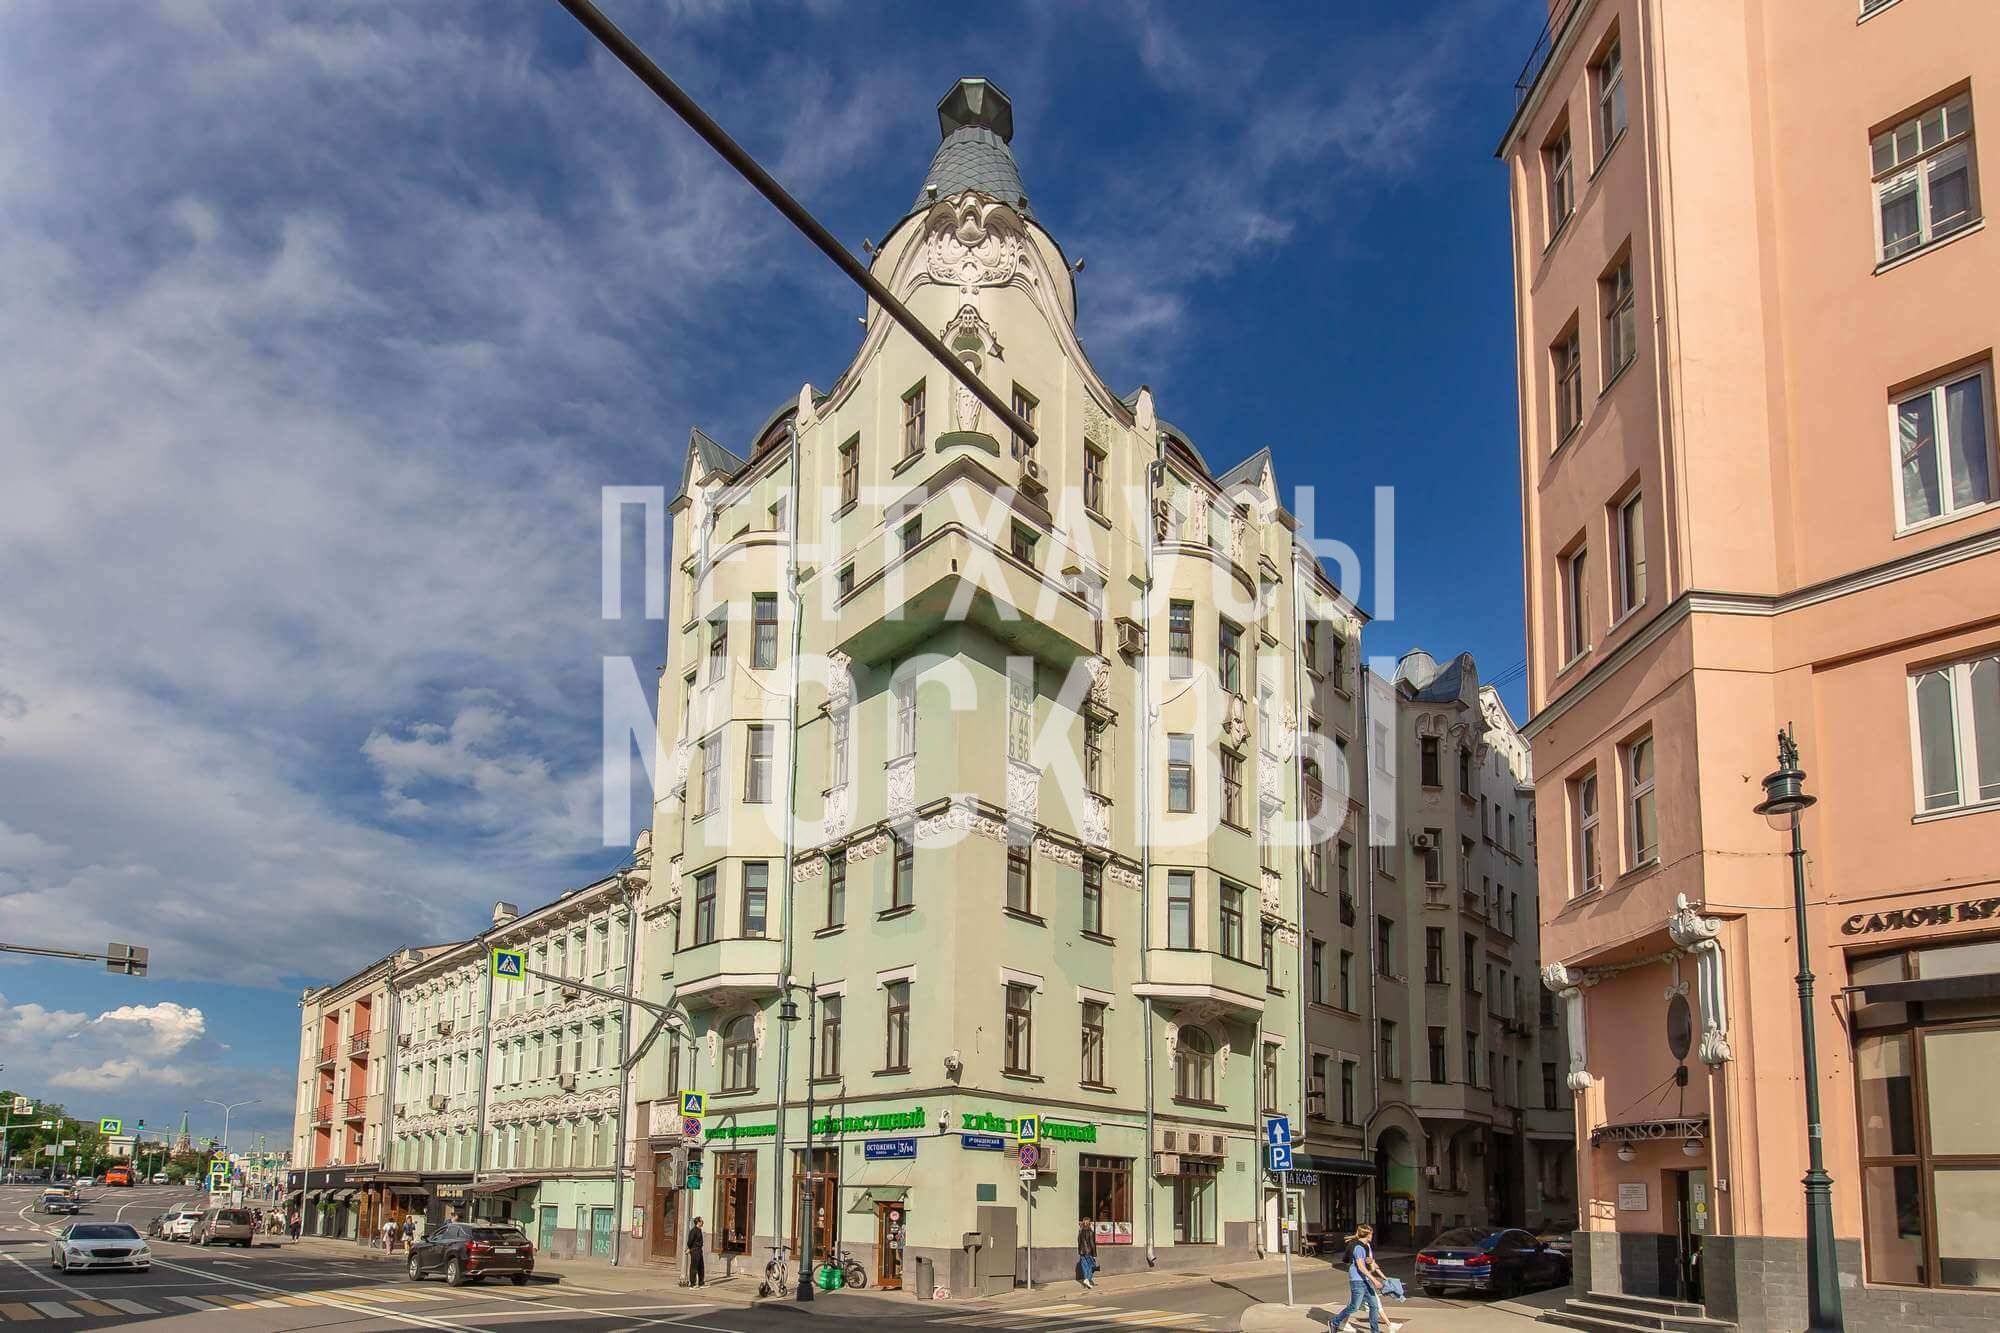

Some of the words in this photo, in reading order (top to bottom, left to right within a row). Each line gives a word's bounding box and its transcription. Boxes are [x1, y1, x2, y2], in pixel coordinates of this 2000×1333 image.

[1841, 902, 1953, 936] САЛОН
[1956, 897, 2000, 923] КР
[843, 1106, 926, 1133] НАСУЩНЫЙ
[866, 1143, 896, 1151] ОСТОЖЕНКА
[1273, 1147, 1285, 1168] P
